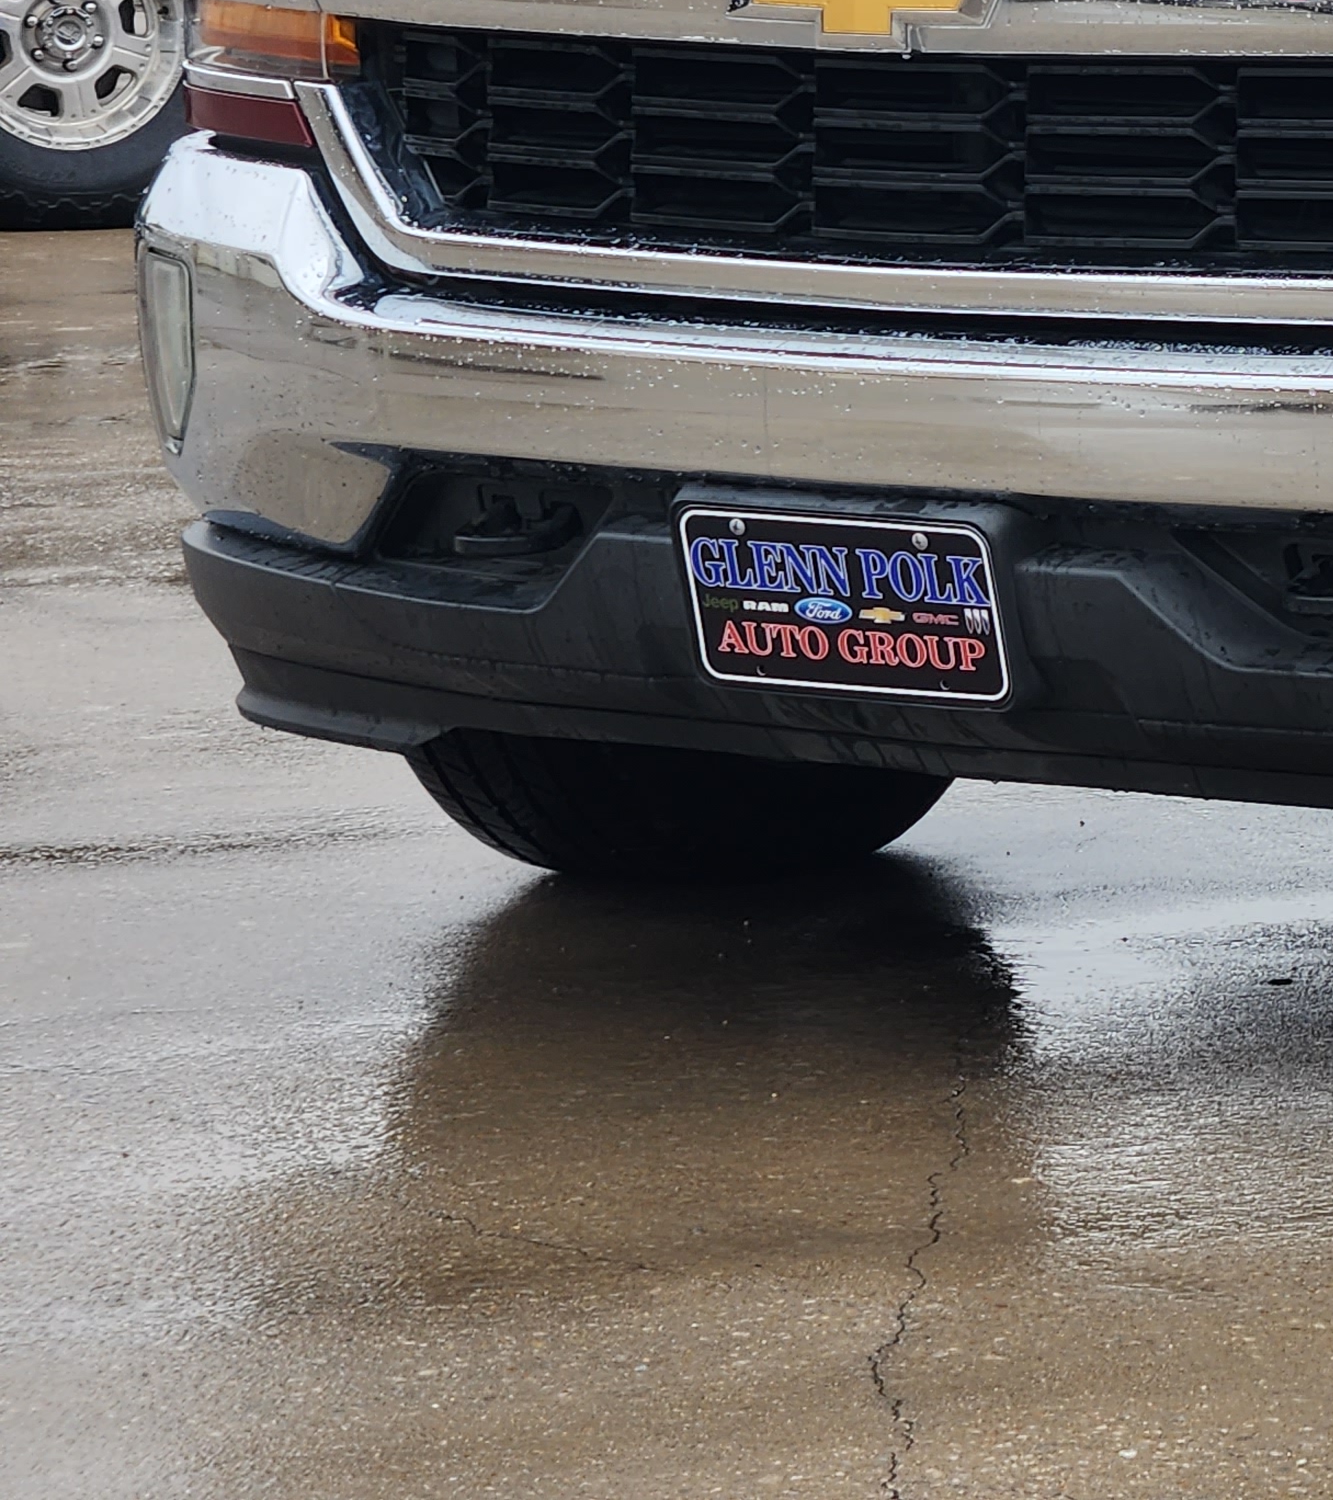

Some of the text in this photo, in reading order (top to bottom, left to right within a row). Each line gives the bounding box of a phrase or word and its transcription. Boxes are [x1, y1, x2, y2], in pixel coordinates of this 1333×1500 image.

[690, 536, 991, 607] GLENN POLK
[703, 594, 959, 626] Jeep RAM Ford GMC
[718, 620, 985, 671] AUTO GROUP
